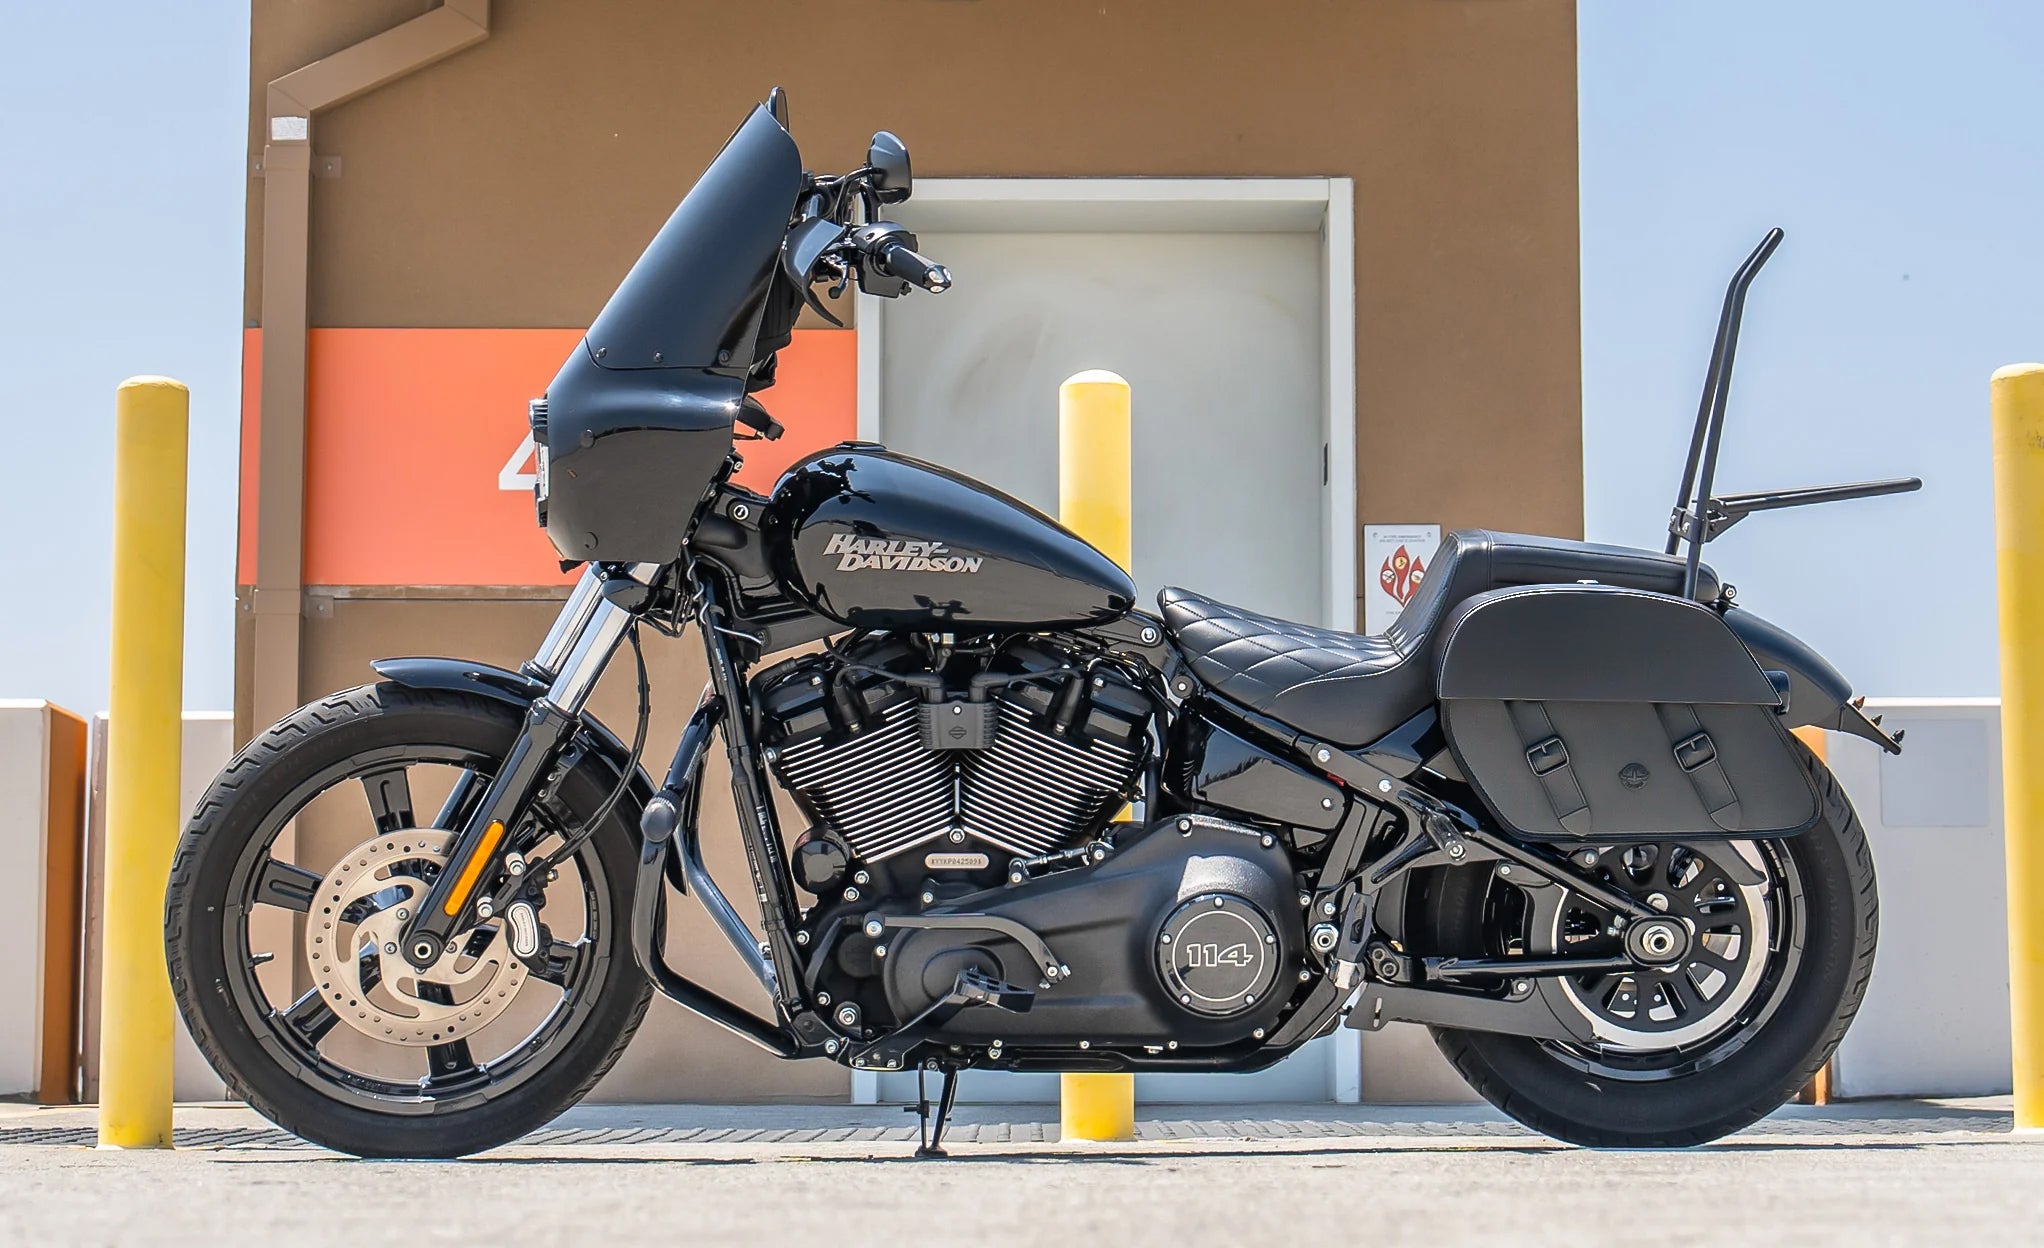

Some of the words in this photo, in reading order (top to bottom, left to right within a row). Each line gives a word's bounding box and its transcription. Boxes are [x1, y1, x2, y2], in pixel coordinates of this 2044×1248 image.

[823, 533, 950, 557] HARLEY-
[836, 552, 984, 574] DAVIDSON
[1186, 943, 1254, 967] 114
